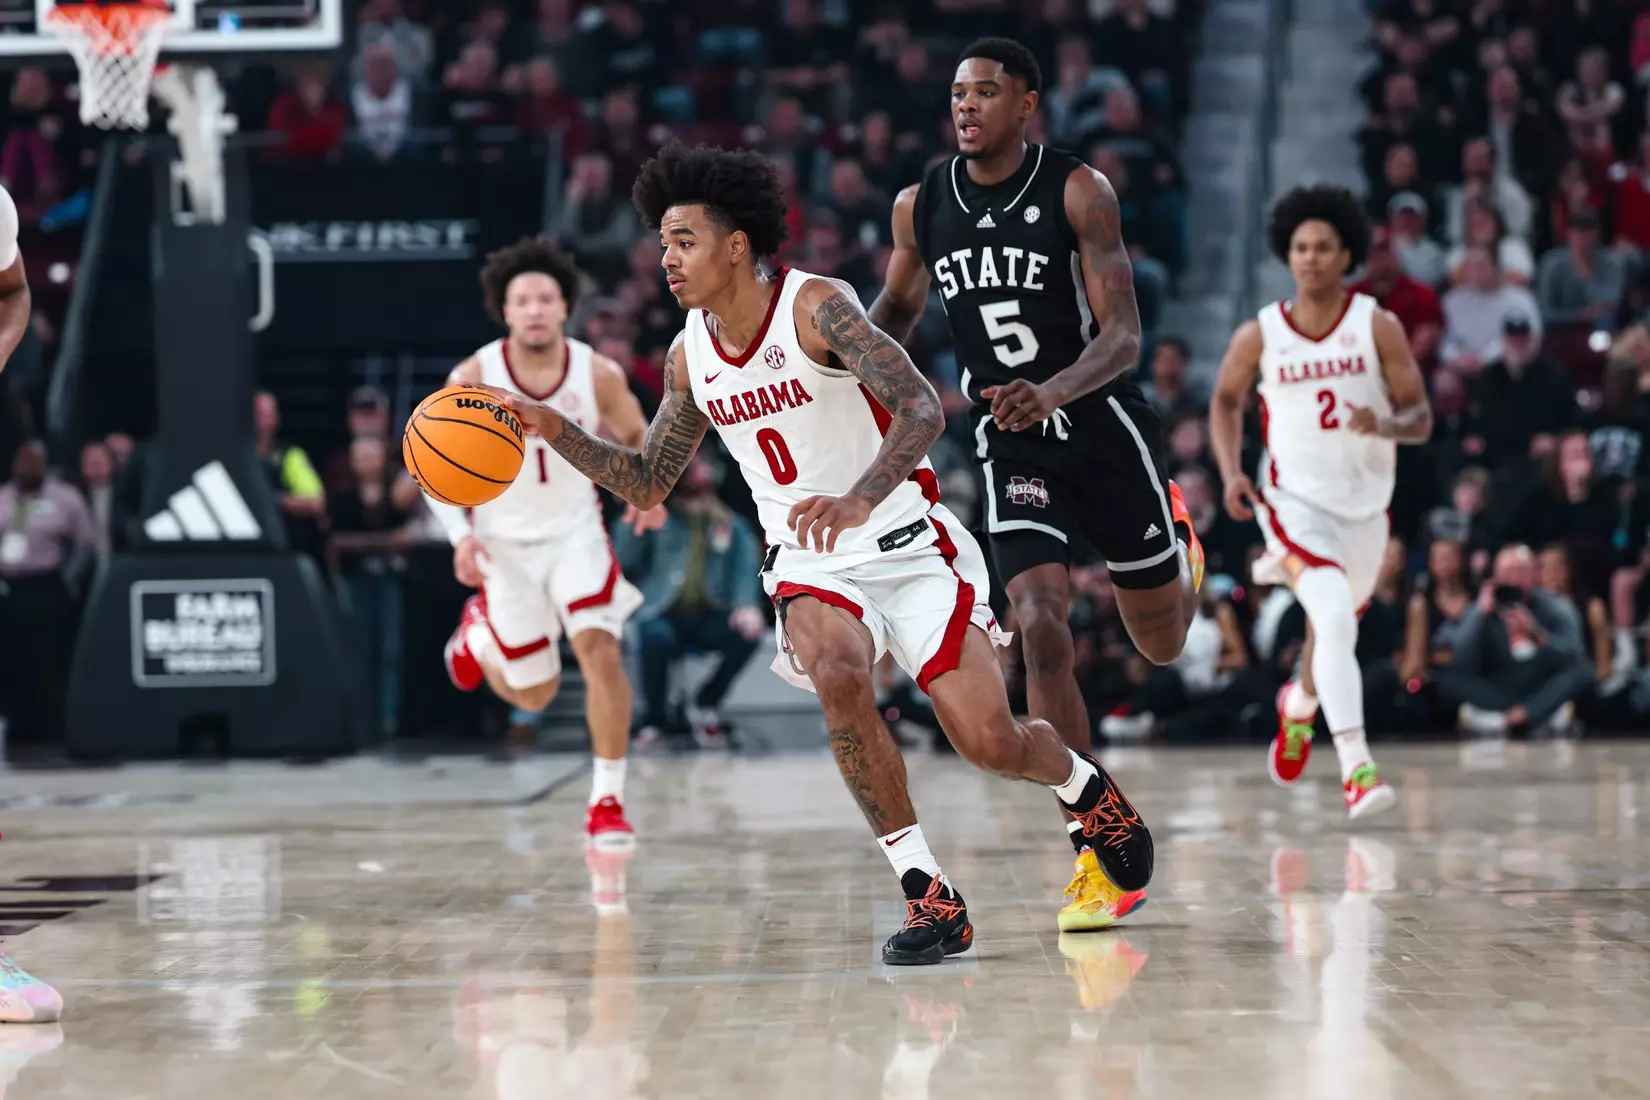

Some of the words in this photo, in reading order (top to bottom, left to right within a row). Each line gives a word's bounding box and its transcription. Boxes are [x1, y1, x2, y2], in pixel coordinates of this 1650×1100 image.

[934, 246, 1049, 300] STATE
[979, 299, 1040, 368] 5
[765, 345, 785, 369] SEC
[1278, 354, 1366, 384] ALABAMA
[455, 397, 523, 443] Wilson
[706, 378, 814, 426] ALABAMA
[1317, 387, 1339, 430] 2
[536, 447, 548, 484] 1
[756, 428, 798, 486] 0
[1014, 485, 1042, 498] STATE
